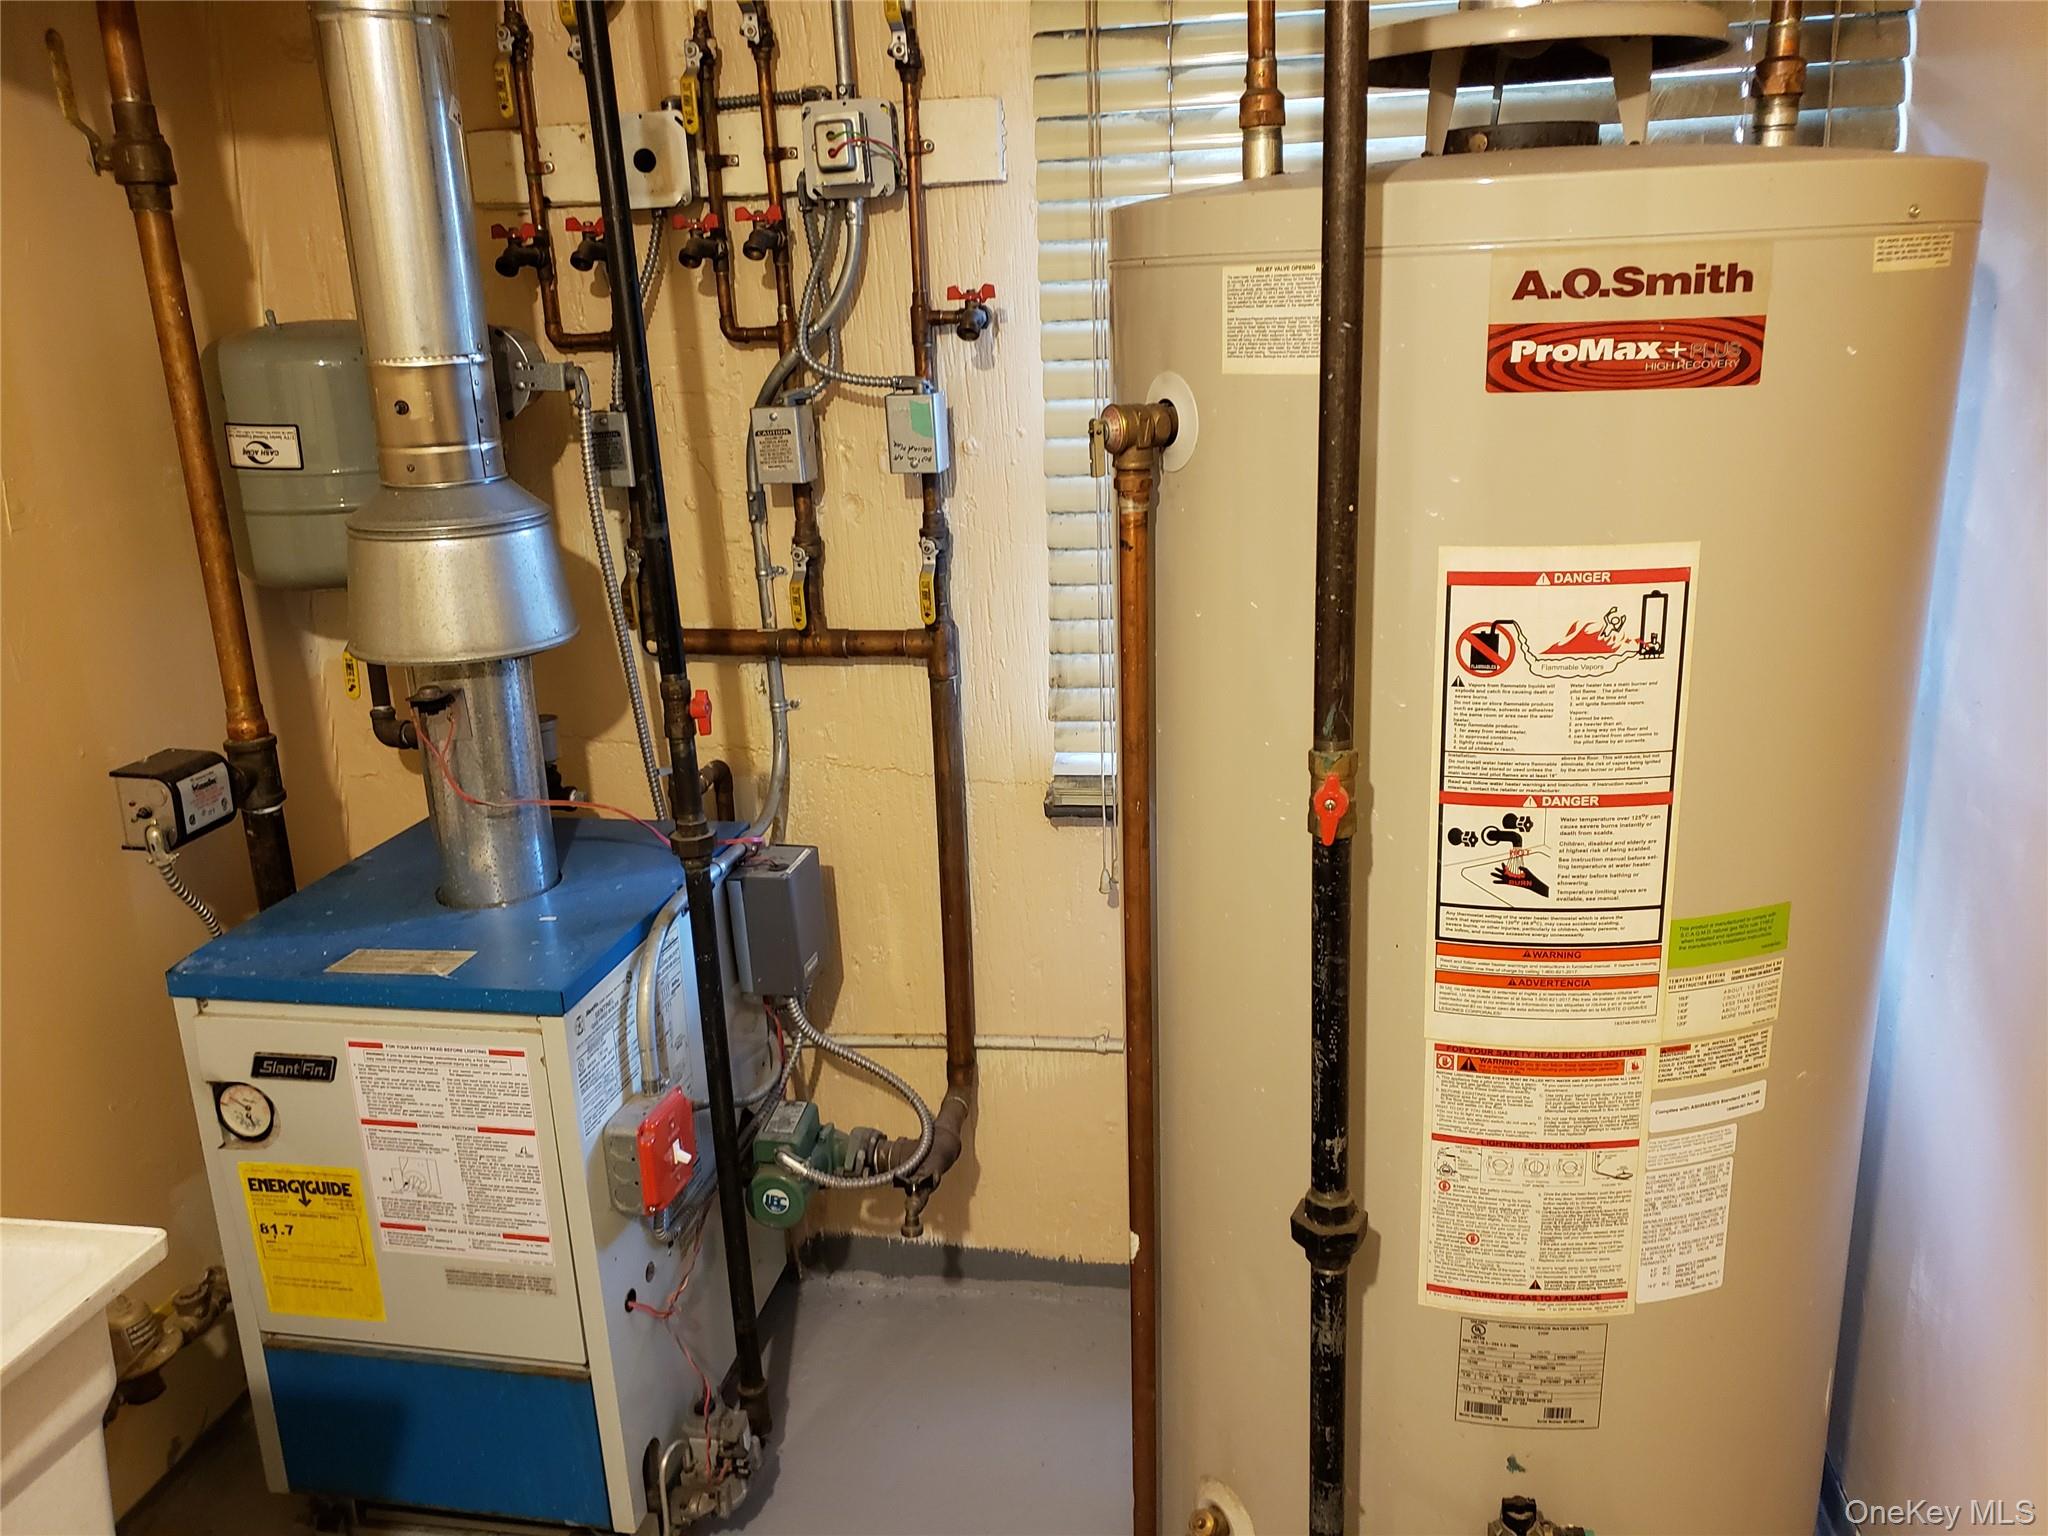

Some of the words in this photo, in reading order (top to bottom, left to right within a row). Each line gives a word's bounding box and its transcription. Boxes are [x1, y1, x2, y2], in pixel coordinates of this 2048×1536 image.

[1510, 338, 1663, 363] ProMax
[1645, 361, 1676, 371] HIGH
[1678, 358, 1740, 370] RECOVERY
[1554, 572, 1610, 583] DANGER
[1580, 663, 1604, 672] Vapors
[1542, 796, 1599, 806] DANGER
[1533, 951, 1582, 959] WARNING
[1519, 979, 1591, 988] ADVERTENCIA
[1466, 1046, 1494, 1055] YOUR
[1494, 1048, 1533, 1058] SAFETY
[1533, 1050, 1559, 1058] READ
[1600, 1049, 1642, 1057] LIGHTING
[1480, 1057, 1520, 1067] WARNING
[1480, 1140, 1524, 1148] LIGHTING
[248, 1178, 352, 1199] ENERGYGUIDE
[260, 1222, 294, 1236] 81.7
[1471, 1290, 1498, 1298] TURN
